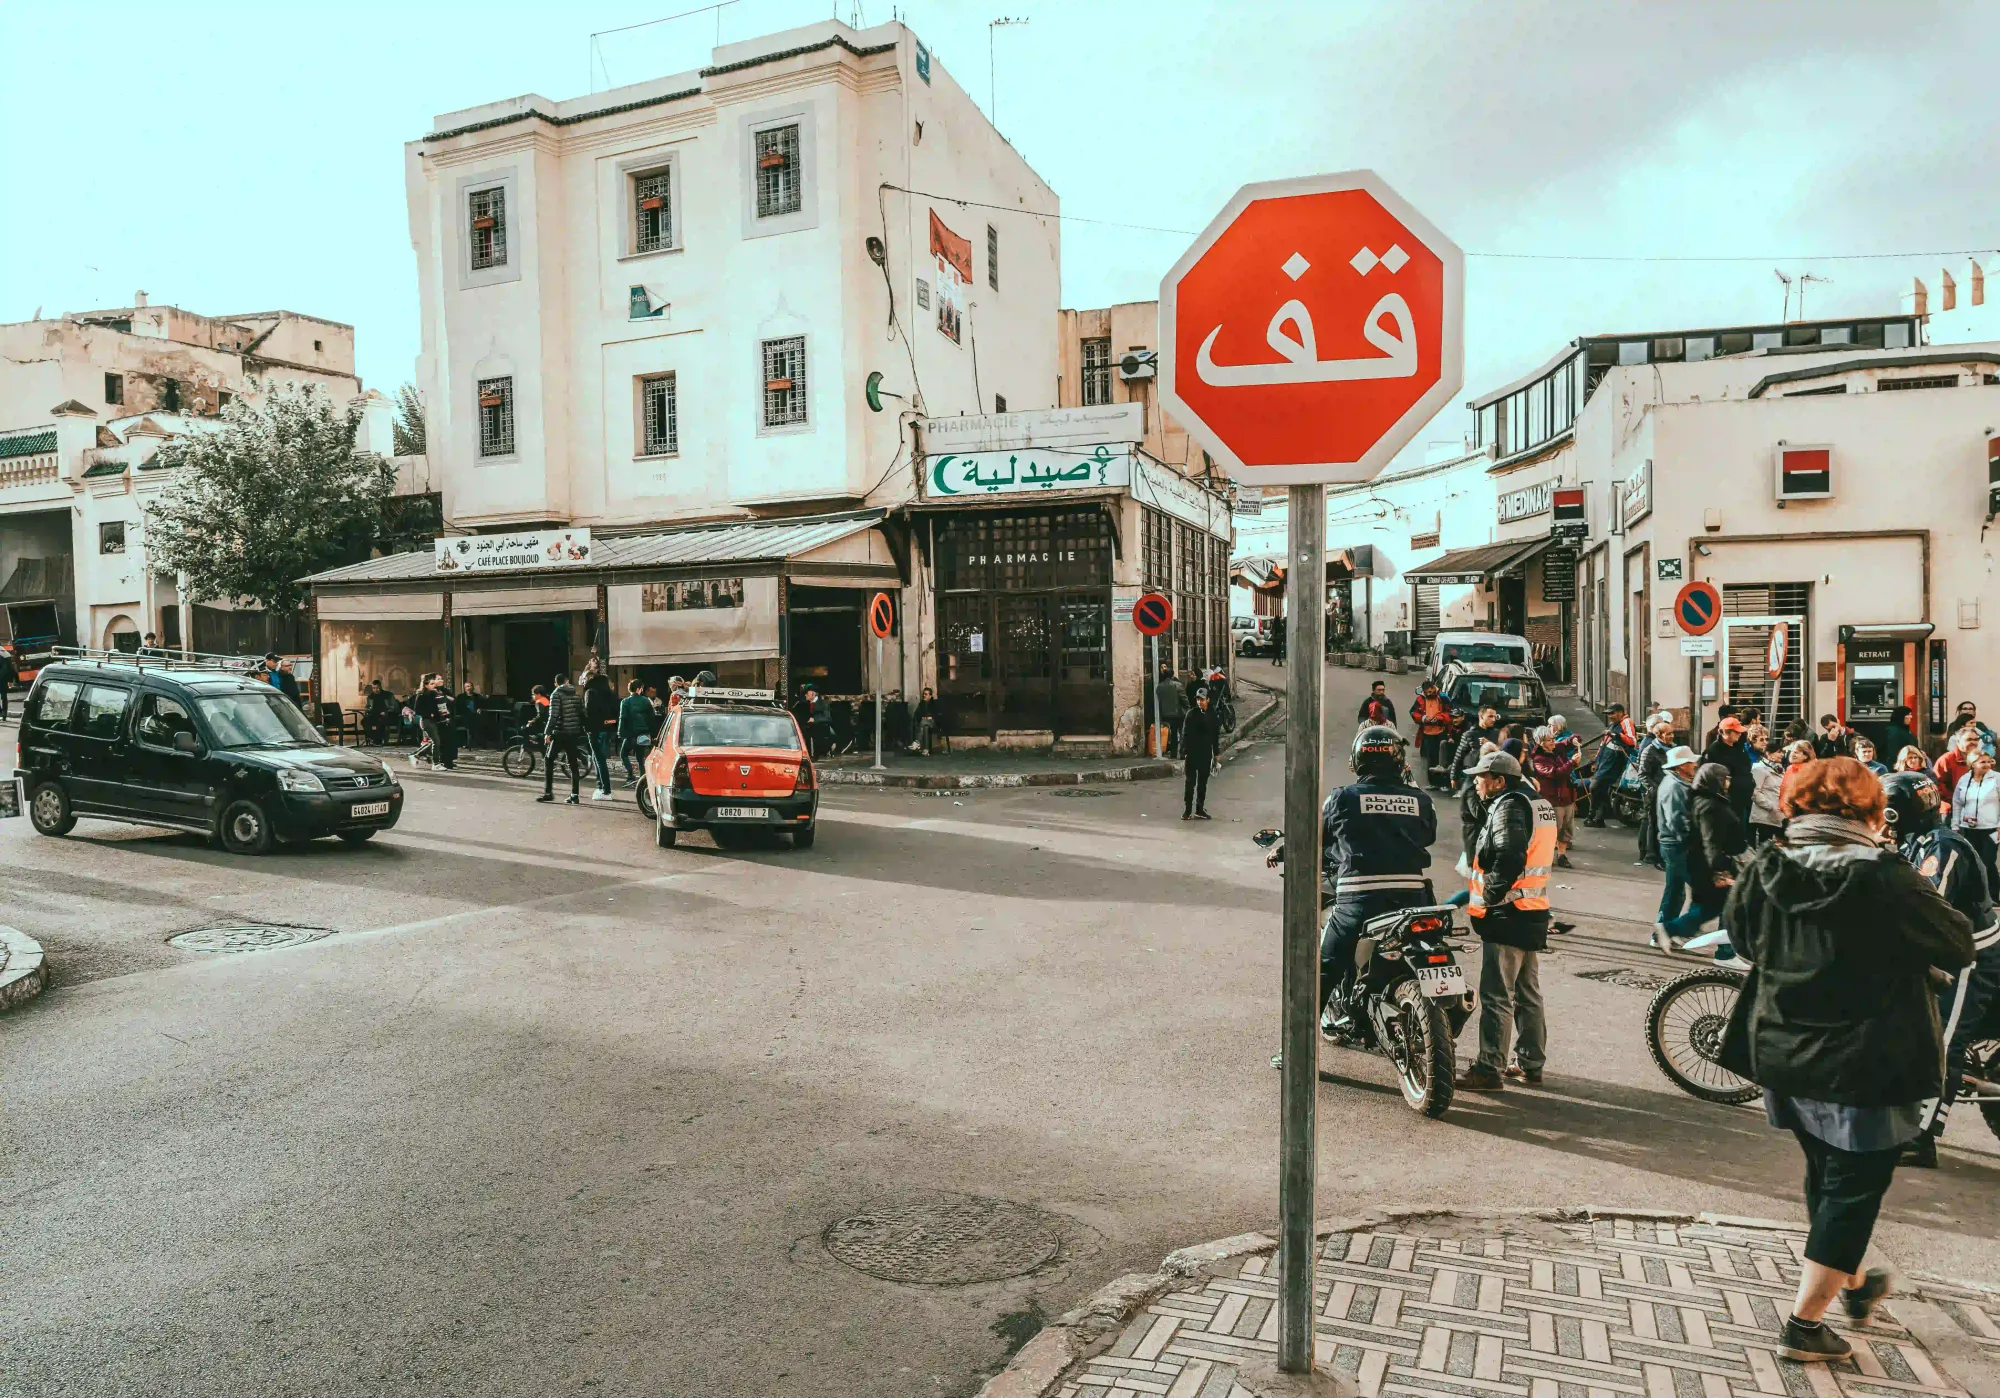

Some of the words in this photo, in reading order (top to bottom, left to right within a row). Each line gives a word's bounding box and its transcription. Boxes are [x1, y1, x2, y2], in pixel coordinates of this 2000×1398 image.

[1196, 243, 1418, 387] قف
[928, 416, 1020, 434] PHARMACIE
[962, 454, 1091, 492] صيدلية
[1505, 486, 1543, 519] MEDINA
[477, 555, 491, 566] CAFÉ
[492, 555, 509, 566] PLACE
[510, 554, 540, 565] BOUJLOUD
[1858, 650, 1891, 658] RETRAIT
[1362, 745, 1394, 753] POLICE
[1364, 796, 1415, 806] الشرطة
[719, 808, 742, 817] 48820
[761, 808, 768, 817] 2
[1365, 804, 1416, 814] POLICE
[1435, 980, 1449, 995] ش
